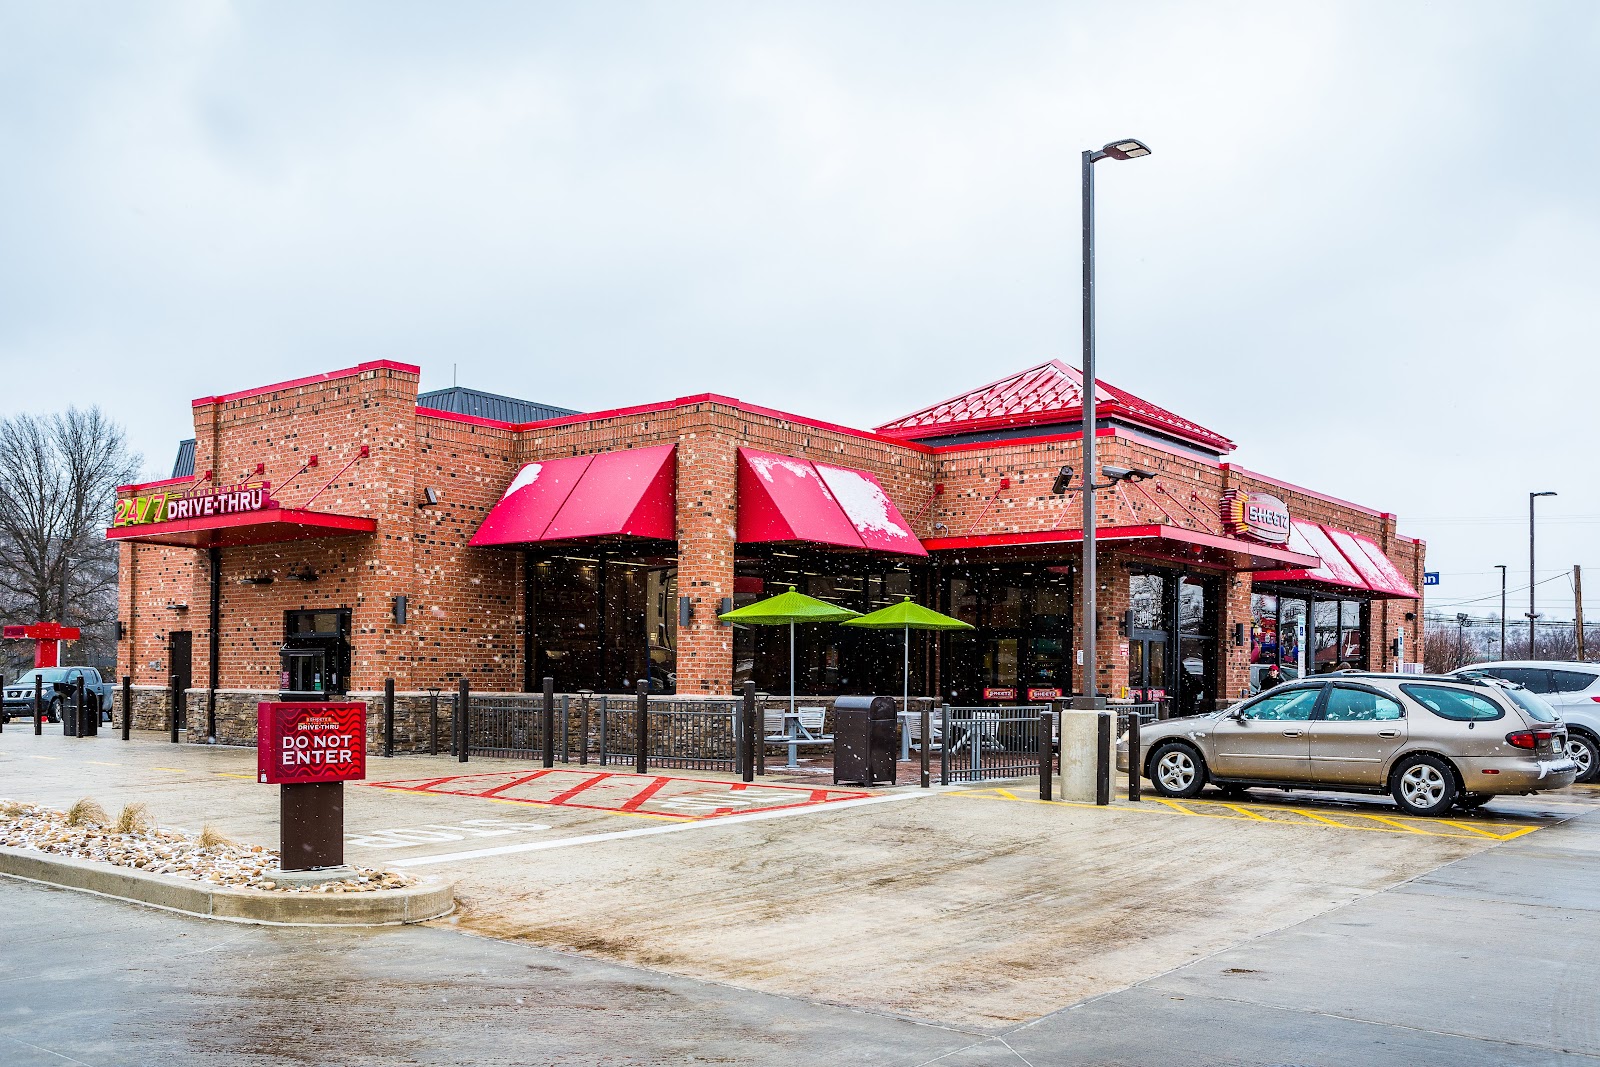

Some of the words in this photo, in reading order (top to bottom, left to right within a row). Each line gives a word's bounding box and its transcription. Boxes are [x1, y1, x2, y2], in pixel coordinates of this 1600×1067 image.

[114, 494, 166, 526] 24/7
[1249, 506, 1288, 529] SHEETZ
[282, 736, 309, 749] DO
[313, 735, 352, 748] NOT
[282, 750, 352, 765] ENTER
